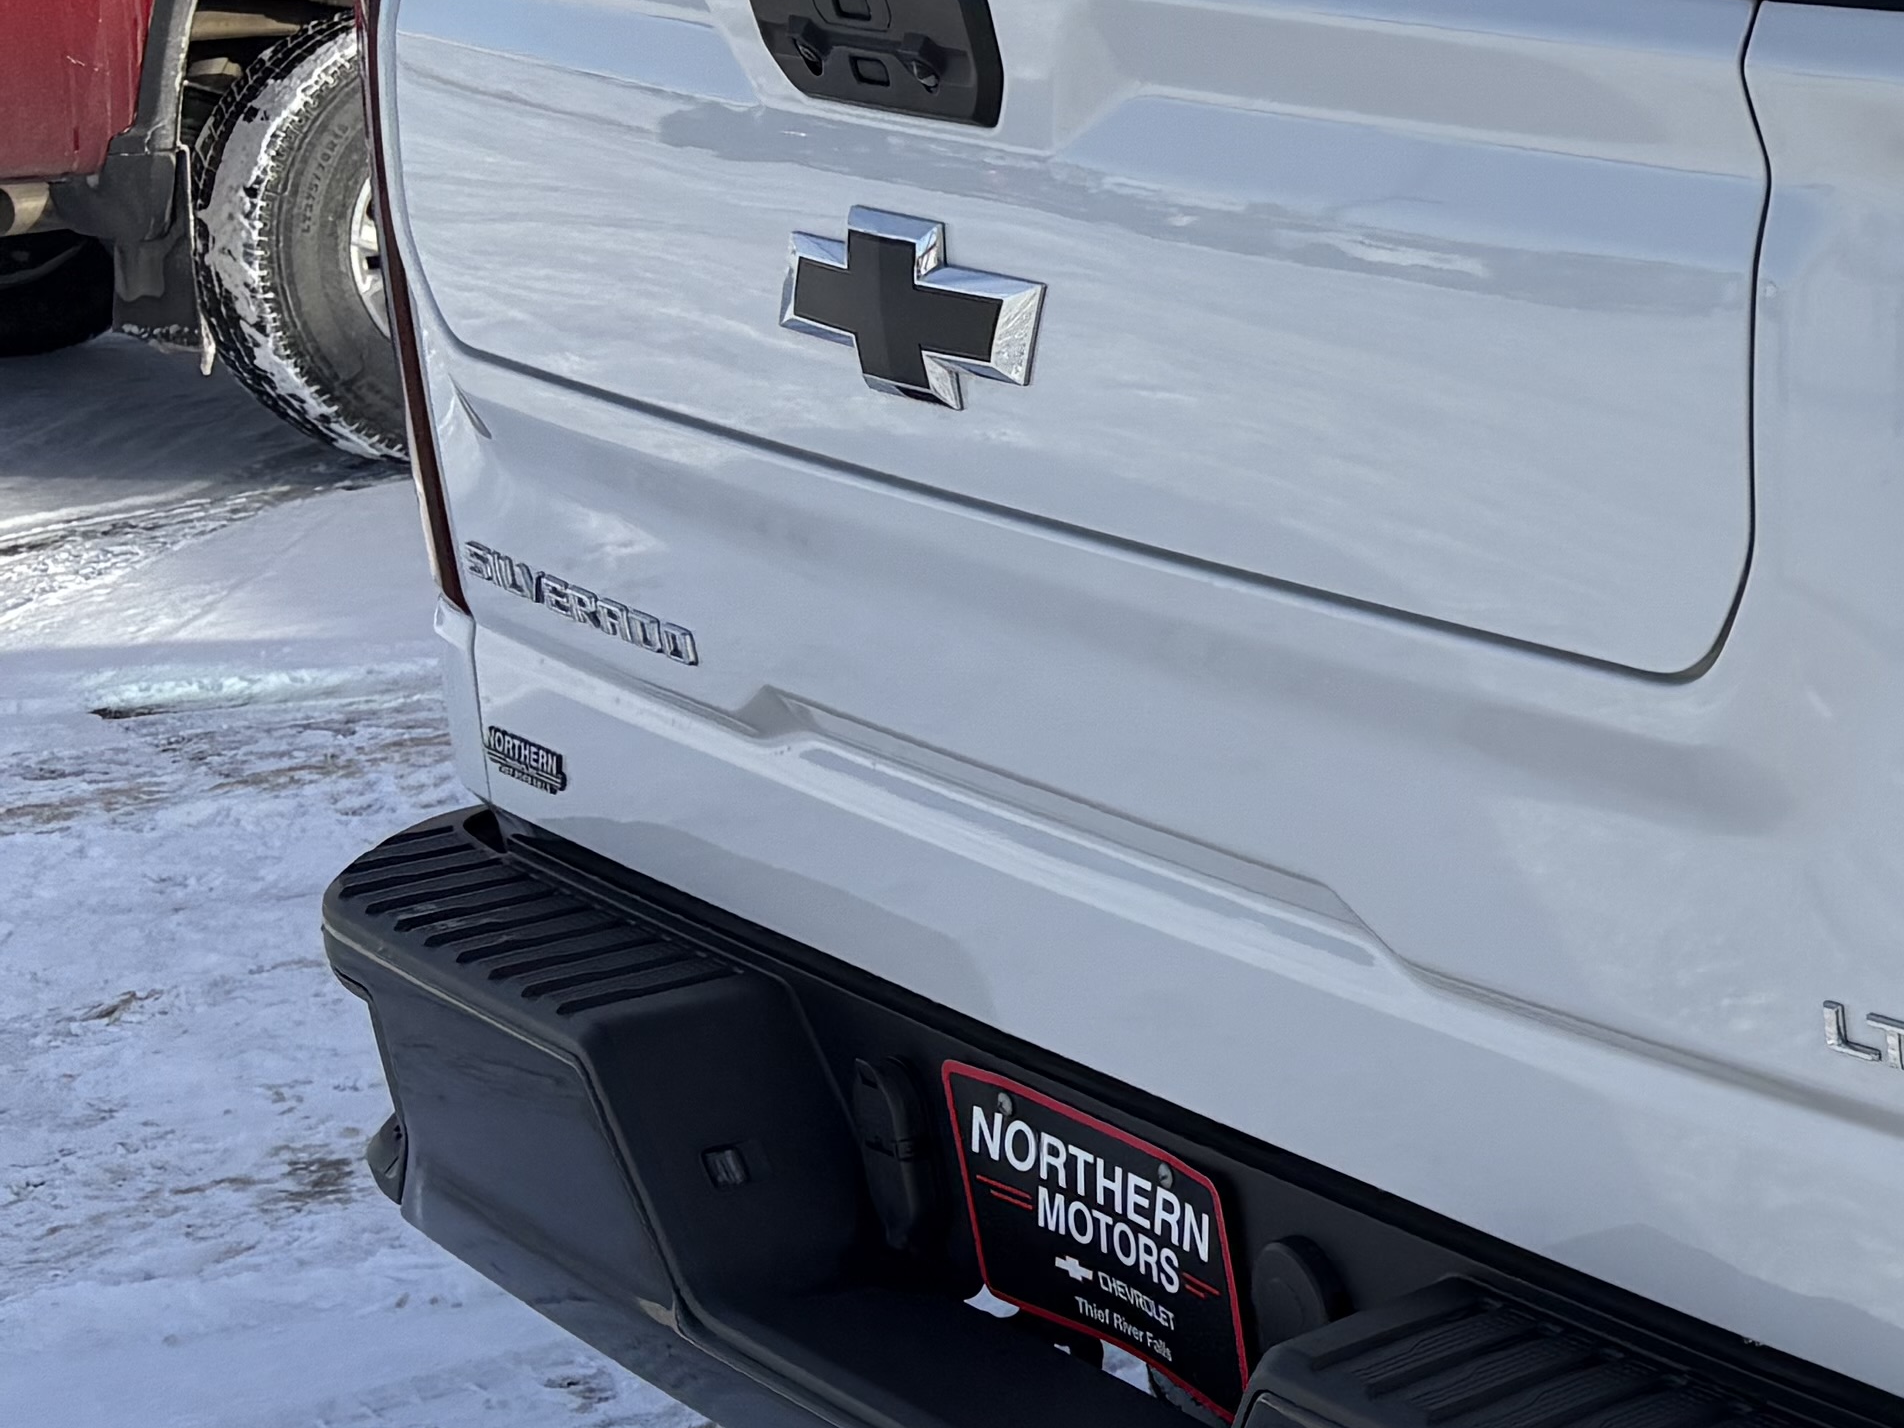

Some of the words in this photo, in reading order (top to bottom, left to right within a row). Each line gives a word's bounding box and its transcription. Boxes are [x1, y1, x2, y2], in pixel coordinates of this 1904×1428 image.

[465, 540, 698, 666] SILVERADO
[484, 729, 557, 775] NORTHERN
[971, 1106, 1209, 1262] NORTHERN
[1038, 1187, 1180, 1294] MOTORS
[1074, 1296, 1111, 1325] Thief
[1114, 1312, 1144, 1343] River
[1147, 1332, 1173, 1362] Falls
[1098, 1272, 1175, 1331] CHEVROLET
